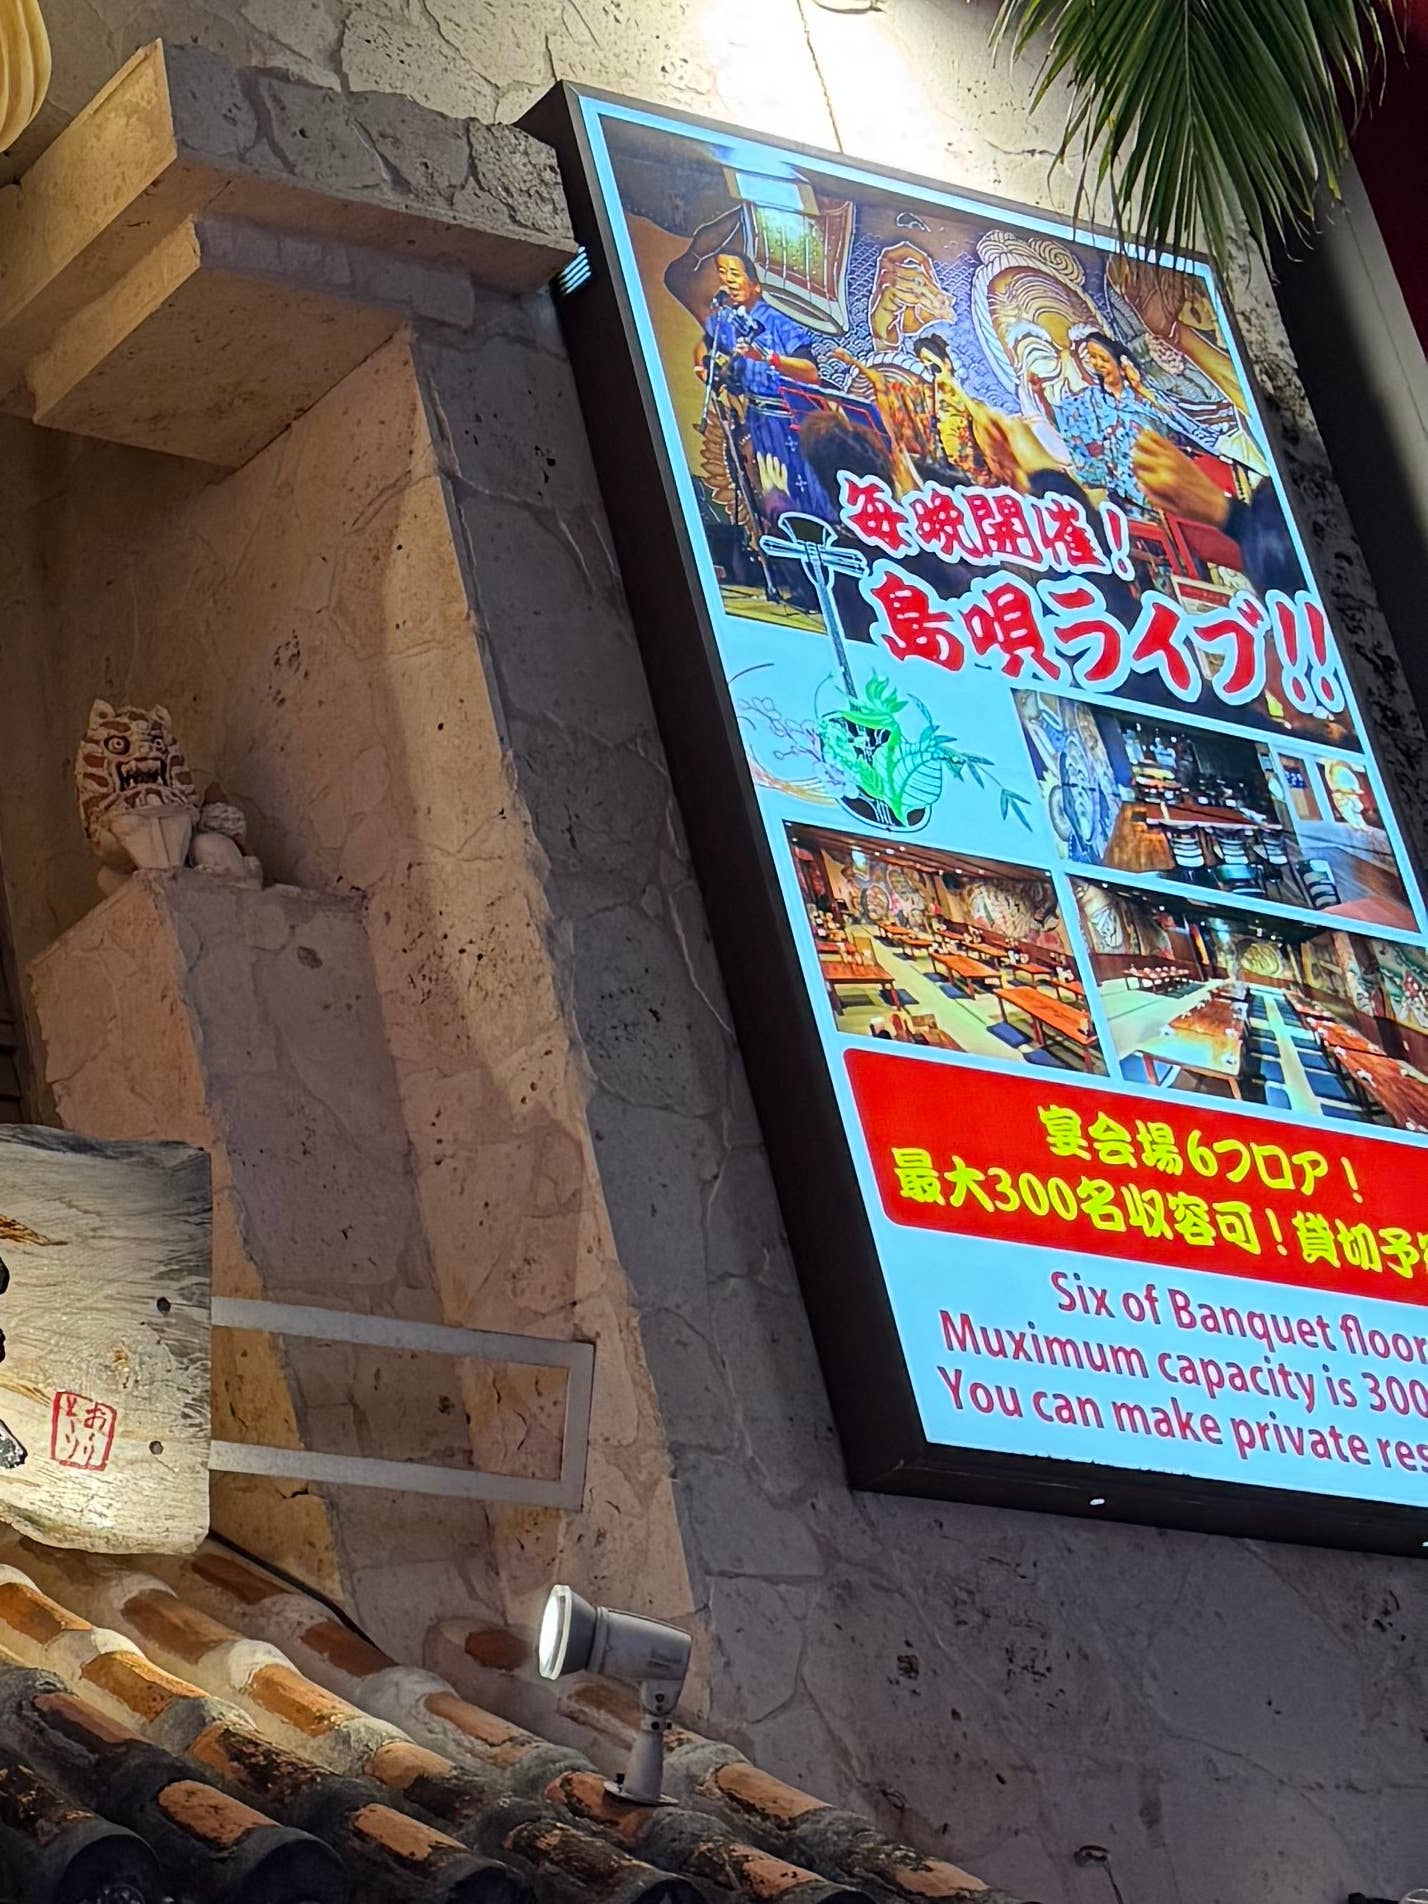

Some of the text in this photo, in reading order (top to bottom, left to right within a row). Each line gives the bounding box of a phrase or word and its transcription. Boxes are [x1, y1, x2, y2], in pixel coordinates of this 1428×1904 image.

[841, 473, 1133, 578] 毎晩開催！
[891, 1147, 1428, 1280] 最大300名収容可！貸切予
[939, 1310, 1149, 1379] Muximum
[1157, 1351, 1316, 1414] capacity
[1322, 1363, 1358, 1409] is
[1051, 1271, 1116, 1319] Six
[1122, 1284, 1161, 1325] of
[1167, 1287, 1338, 1353] Banquet
[937, 1366, 1024, 1418] You
[1032, 1390, 1105, 1429] can
[1111, 1397, 1224, 1445] make
[1230, 1411, 1372, 1466] private
